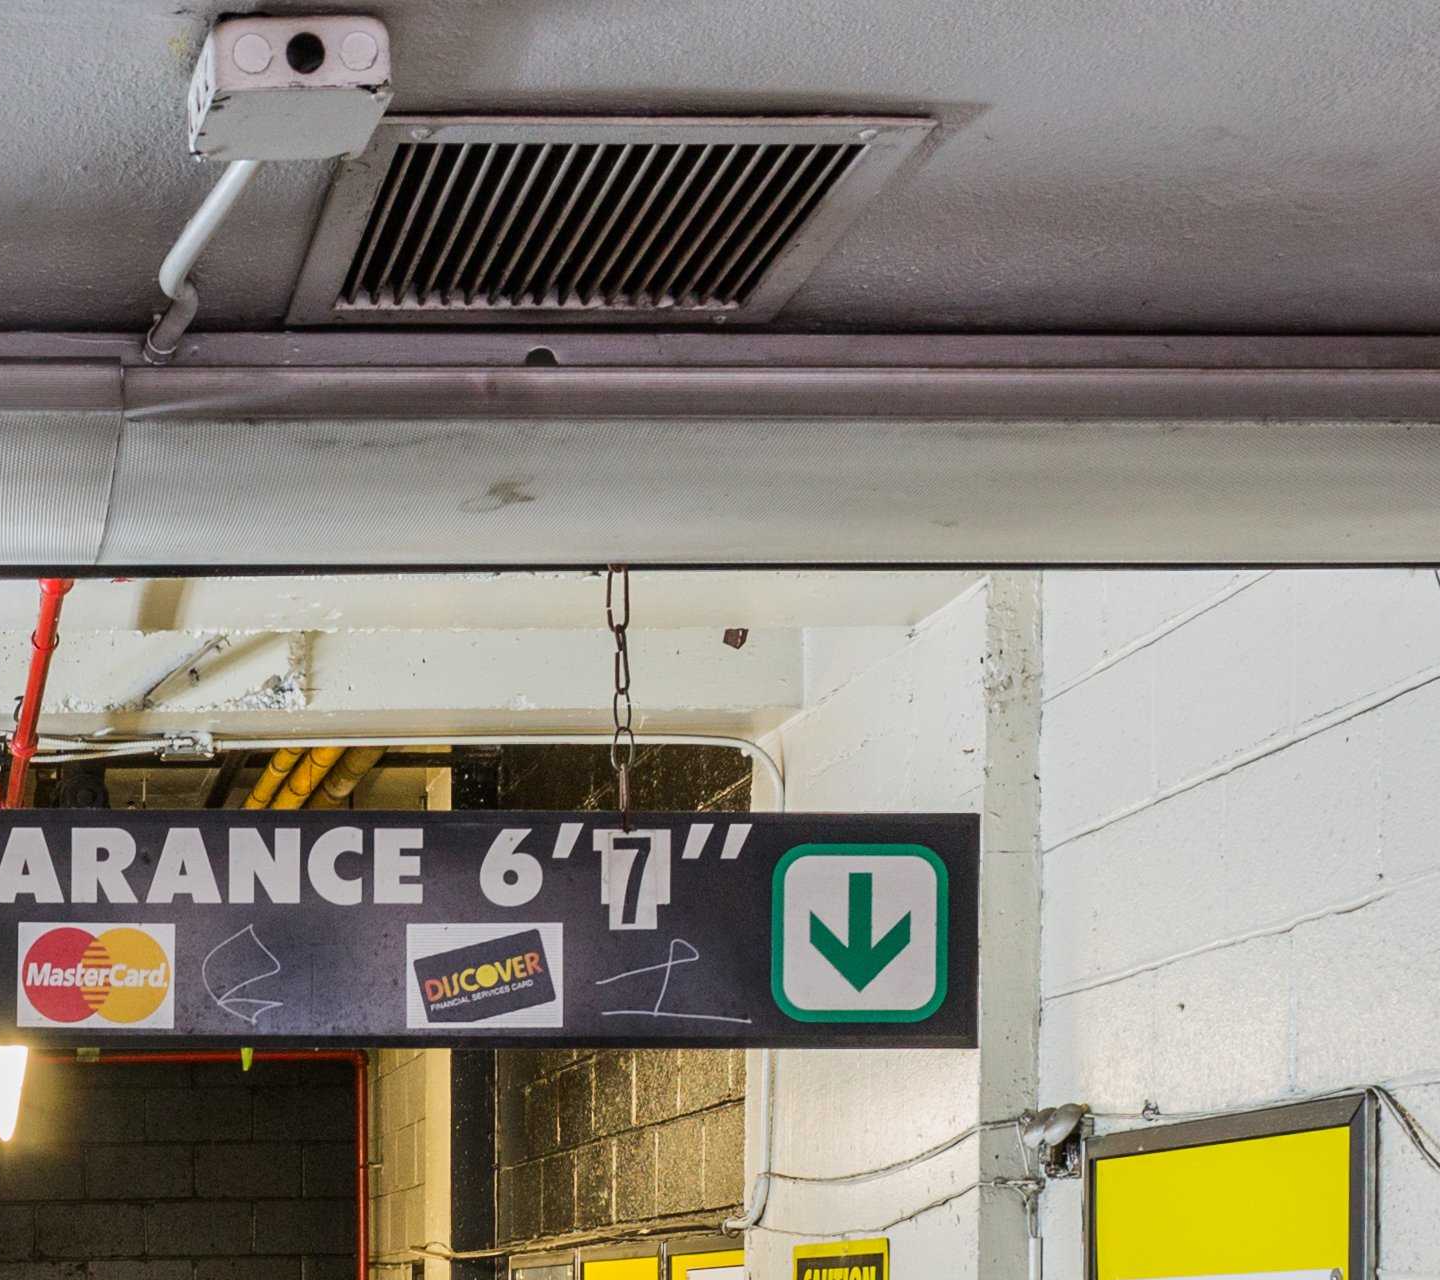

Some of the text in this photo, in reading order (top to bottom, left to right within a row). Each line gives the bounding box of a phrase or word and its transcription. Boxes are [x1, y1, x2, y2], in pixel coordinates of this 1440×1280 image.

[26, 962, 166, 989] MasterCard
[424, 951, 544, 1003] DISCOVER
[430, 979, 534, 1012] FINANCIAL SERVICES CARD
